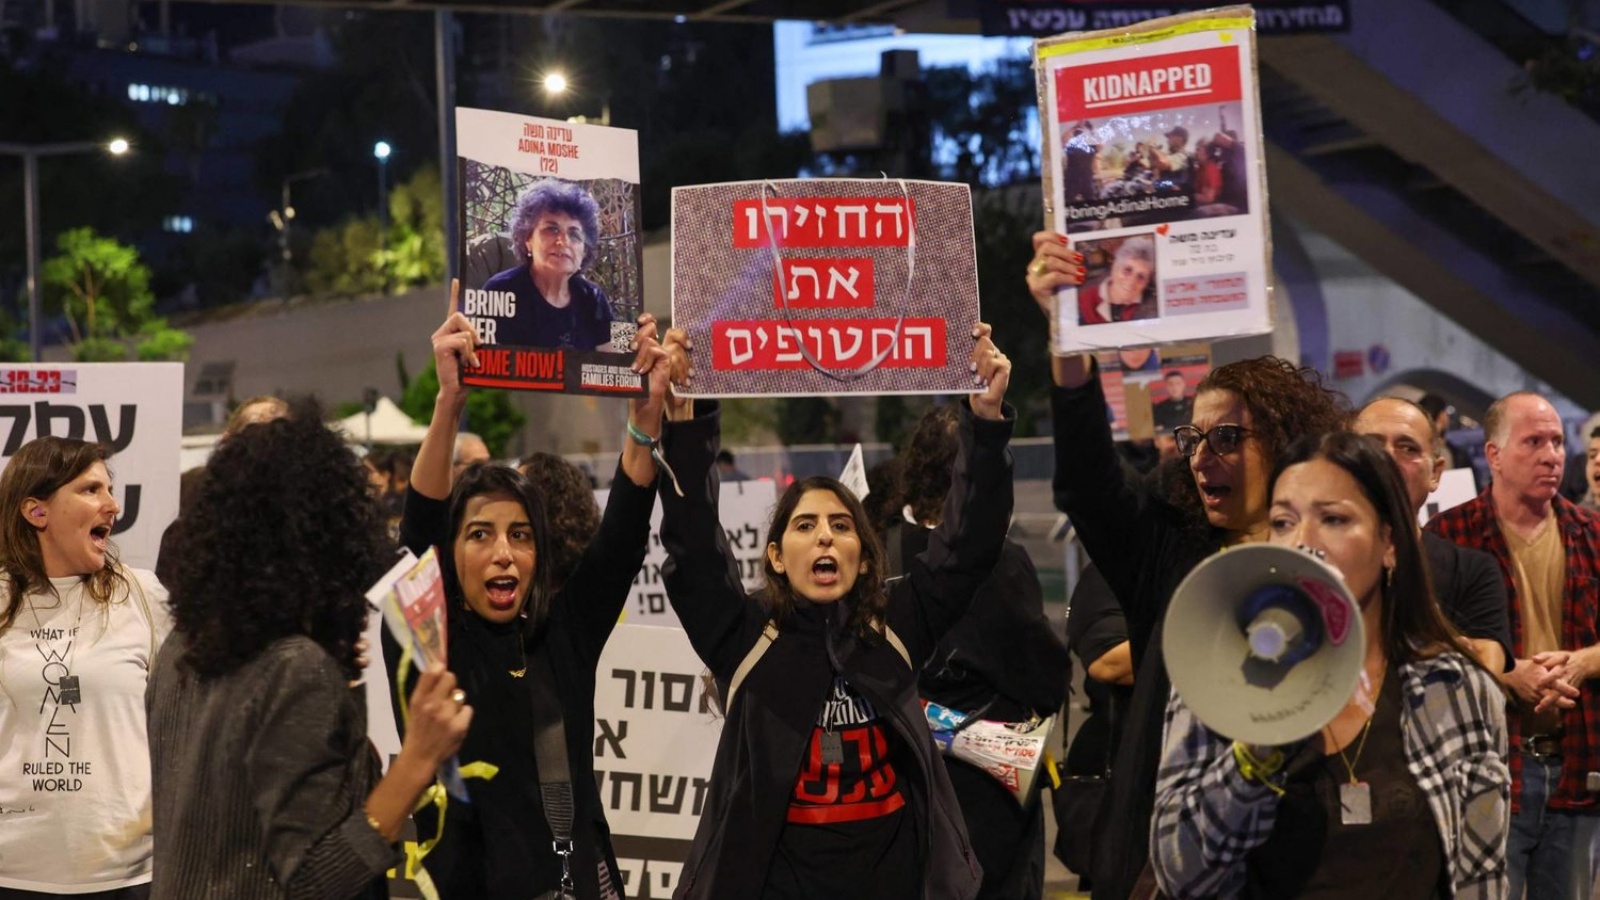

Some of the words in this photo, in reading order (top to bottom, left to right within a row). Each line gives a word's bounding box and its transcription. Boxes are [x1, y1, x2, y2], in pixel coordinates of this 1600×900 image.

[1007, 7, 1087, 31] עכשיו
[1083, 63, 1212, 103] KIDNAPPED
[523, 122, 544, 140] משה
[546, 126, 572, 142] עדינה
[518, 138, 545, 154] ADINA
[547, 143, 579, 159] MOSHE
[540, 157, 558, 174] (72)
[745, 202, 903, 240] החזירו
[788, 265, 860, 300] את
[465, 289, 516, 318] BRING
[725, 325, 932, 365] החטופים
[464, 348, 511, 377] OME
[515, 349, 564, 381] NOW!
[581, 372, 614, 387] FAMILIES
[615, 375, 642, 388] FORUM
[726, 523, 758, 550] לא
[30, 629, 64, 640] WHAT
[23, 762, 64, 775] RULED
[68, 762, 92, 775] THE
[33, 779, 83, 792] WORLD
